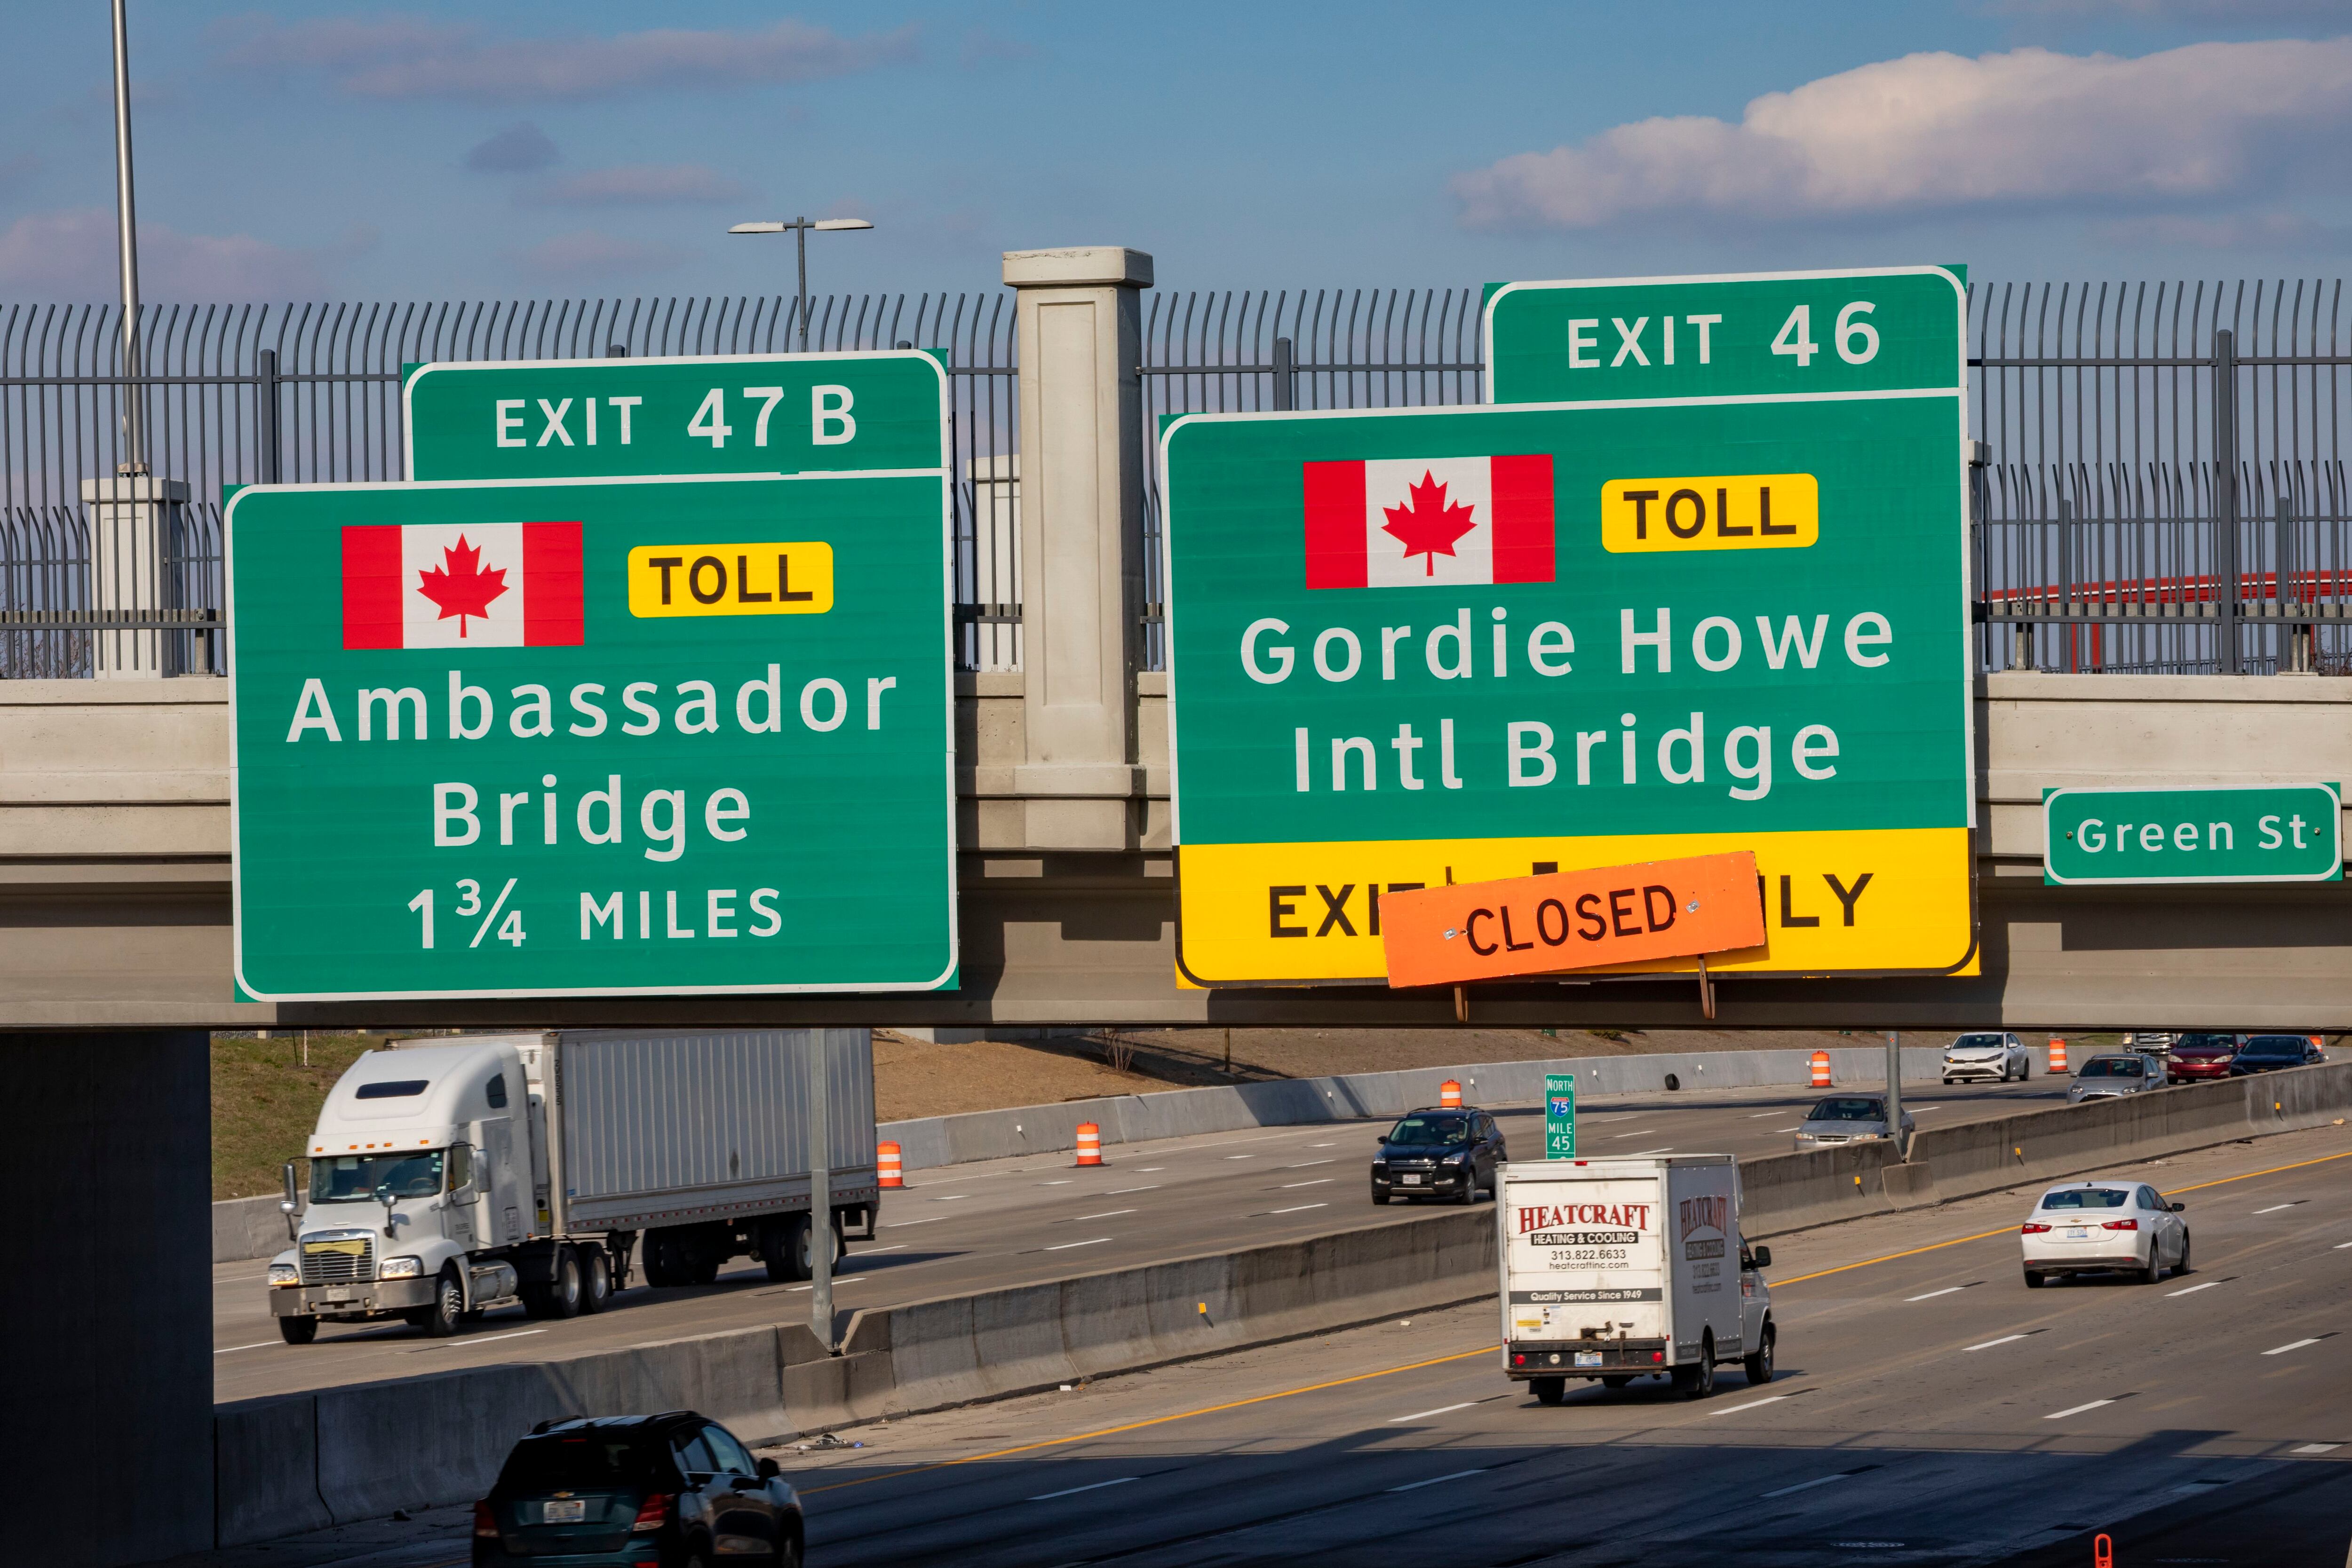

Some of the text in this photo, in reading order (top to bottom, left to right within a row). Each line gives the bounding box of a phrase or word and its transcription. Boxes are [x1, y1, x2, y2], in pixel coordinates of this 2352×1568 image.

[1569, 301, 1880, 369] EXIT 46
[496, 396, 642, 448] EXIT
[1623, 486, 1796, 539] TOLL
[649, 554, 813, 605] TOLL
[1240, 606, 1892, 685] Gordie Howe
[286, 663, 896, 743] Ambassador
[1295, 712, 1840, 801] Intl Bridge
[434, 774, 750, 862] Bridge
[2077, 814, 2307, 853] Green St
[580, 887, 782, 940] MILES
[1270, 873, 1874, 938] EXI LY
[1467, 885, 1677, 956] CLOSED
[1547, 1079, 1573, 1092] NORTH
[1552, 1101, 1568, 1113] 75
[1548, 1123, 1573, 1134] MILE
[1552, 1136, 1570, 1150] 45
[1519, 1204, 1650, 1234] HEATCRAFT
[1534, 1232, 1636, 1244] HEATING & COOLING
[1549, 1261, 1629, 1270] heatcraftinc.com
[1551, 1249, 1626, 1260] 313.822.6633
[1530, 1290, 1642, 1302] Quality Service Since 1949
